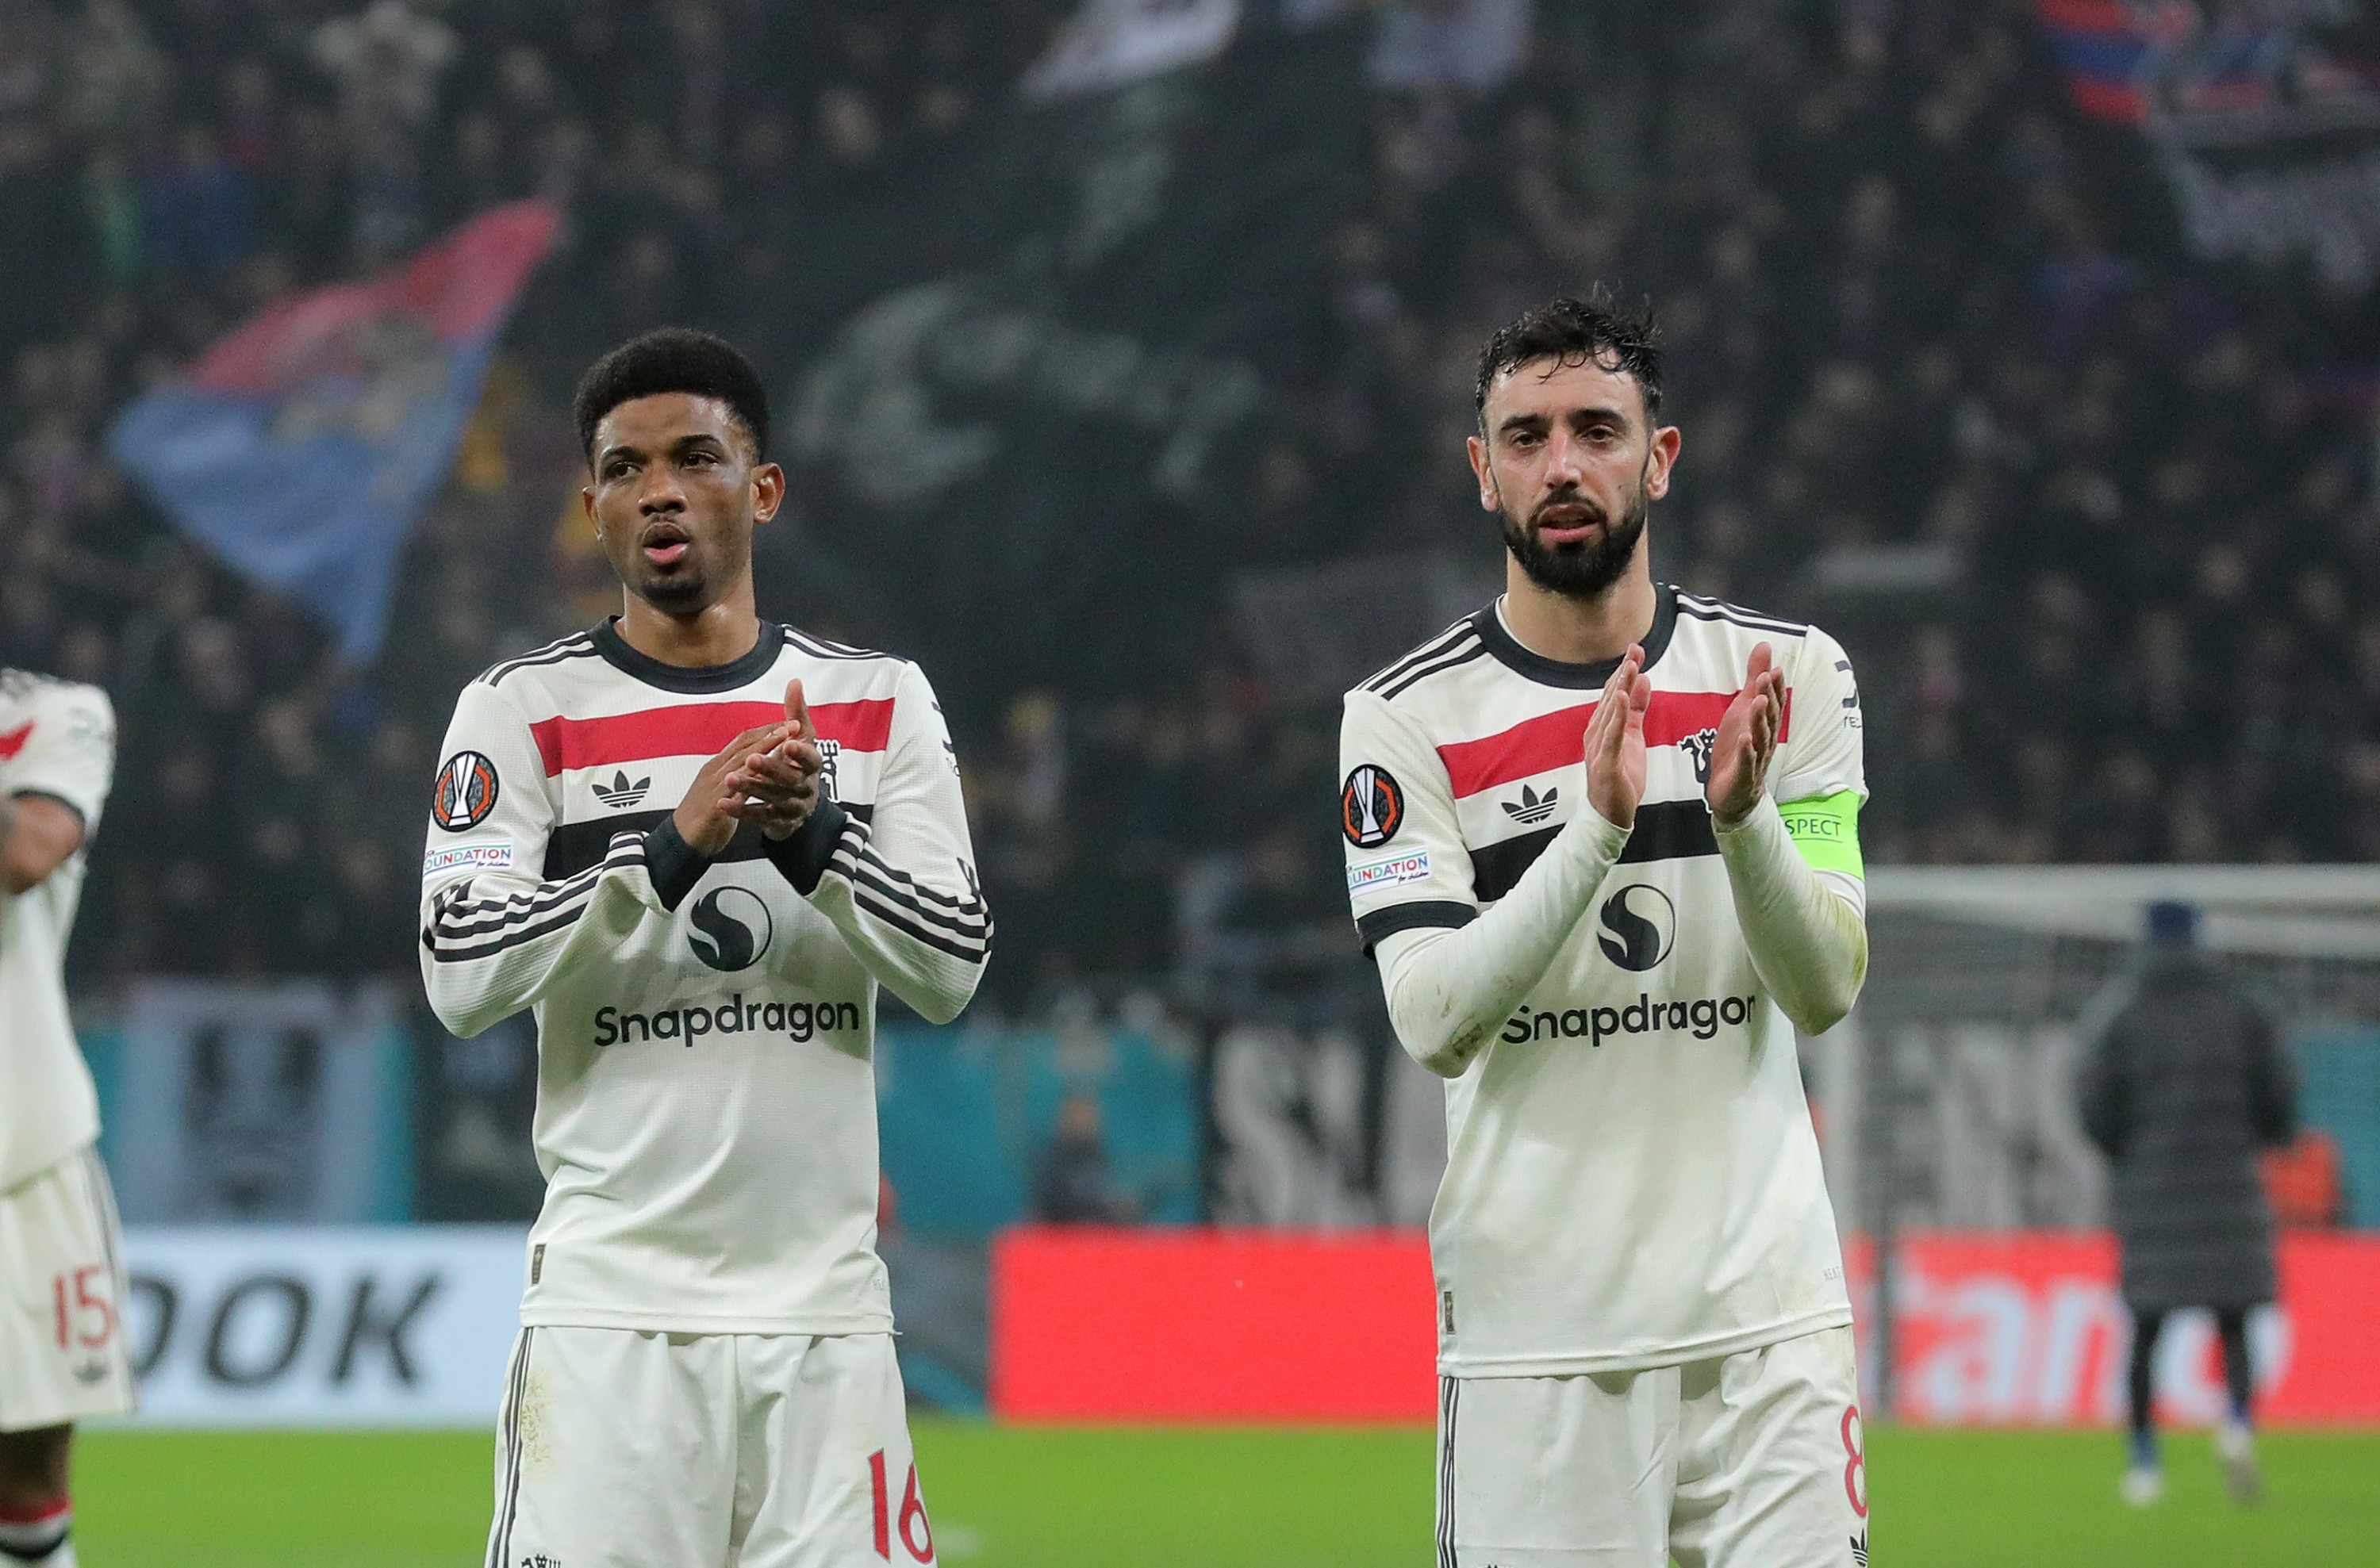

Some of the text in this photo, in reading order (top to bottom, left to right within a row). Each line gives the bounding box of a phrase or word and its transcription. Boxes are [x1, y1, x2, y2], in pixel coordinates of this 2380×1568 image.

[594, 993, 860, 1048] Snapdragon
[52, 1267, 116, 1349] 15
[868, 1447, 934, 1564] 16
[1841, 1403, 1868, 1518] 8
